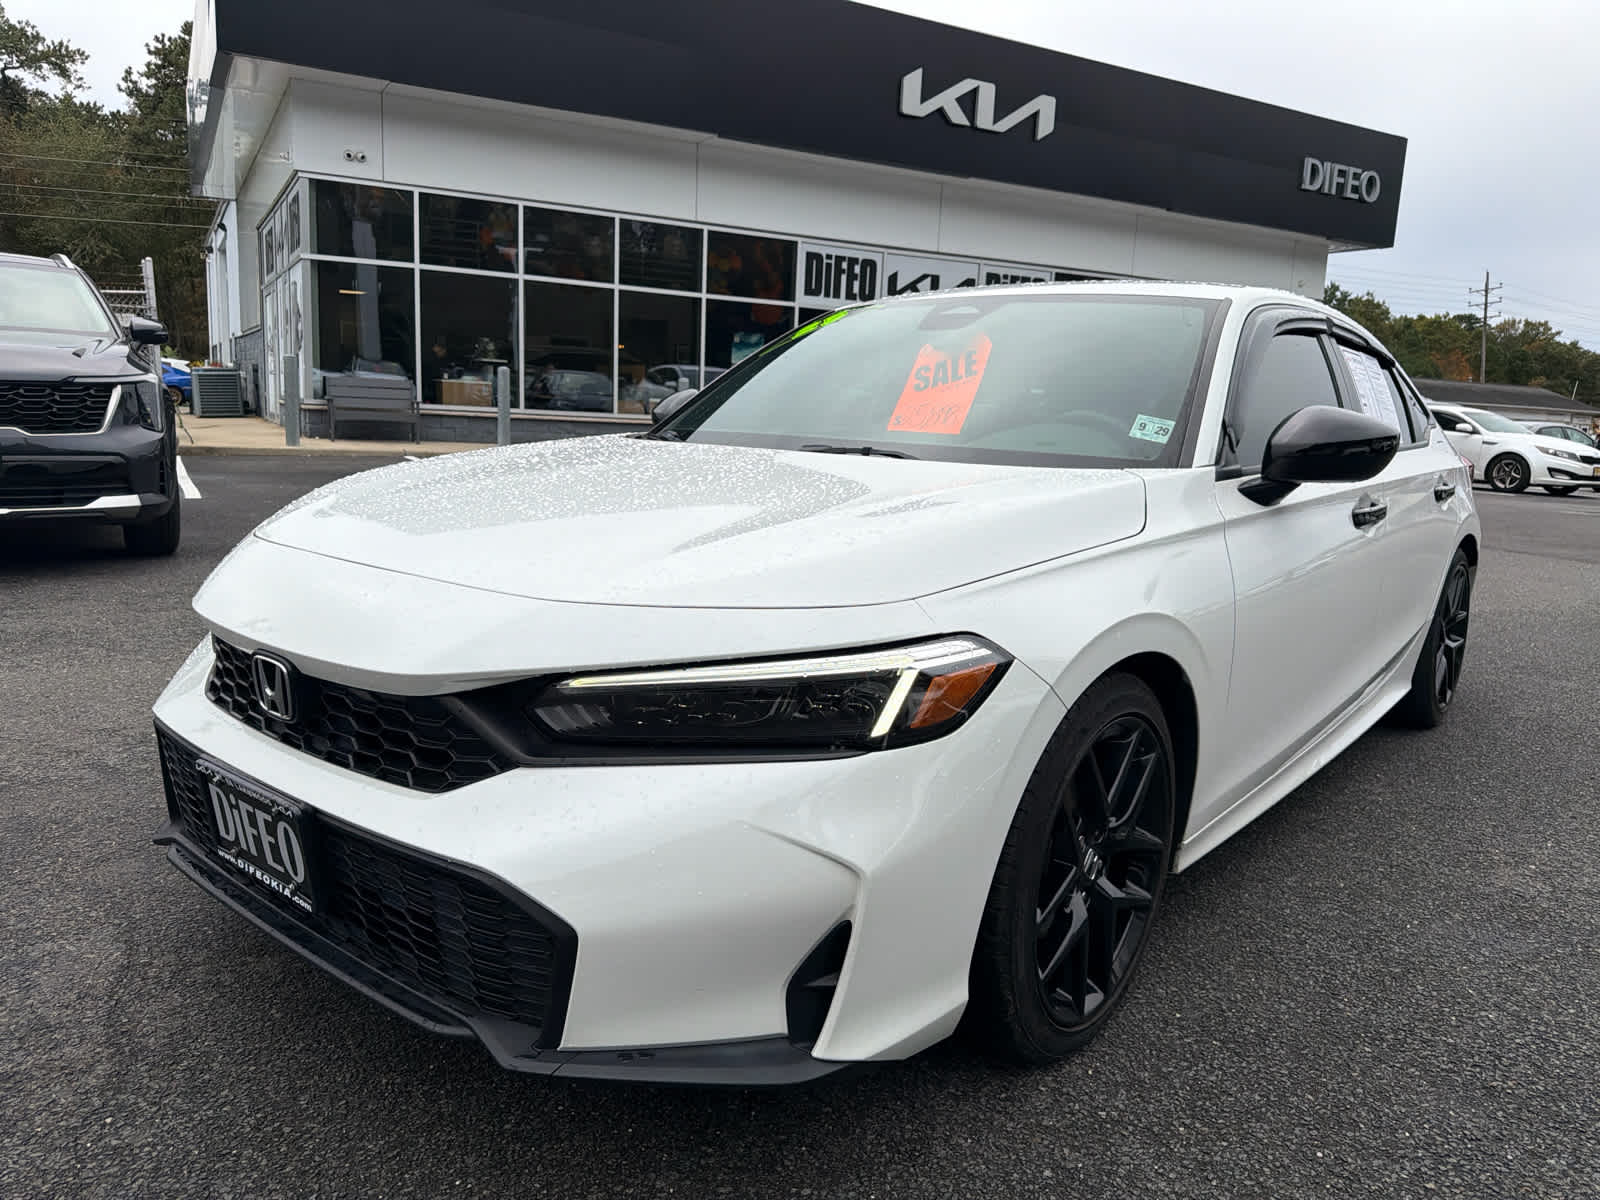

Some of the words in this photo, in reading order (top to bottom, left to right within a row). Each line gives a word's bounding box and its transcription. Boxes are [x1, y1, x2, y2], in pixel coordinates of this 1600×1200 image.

[901, 67, 1056, 141] KIA
[1301, 157, 1381, 203] DIFEO
[913, 350, 980, 393] SALE
[1153, 425, 1170, 437] 29
[208, 782, 305, 884] DiFEO
[217, 848, 313, 913] www.DIFEOKIA.com
